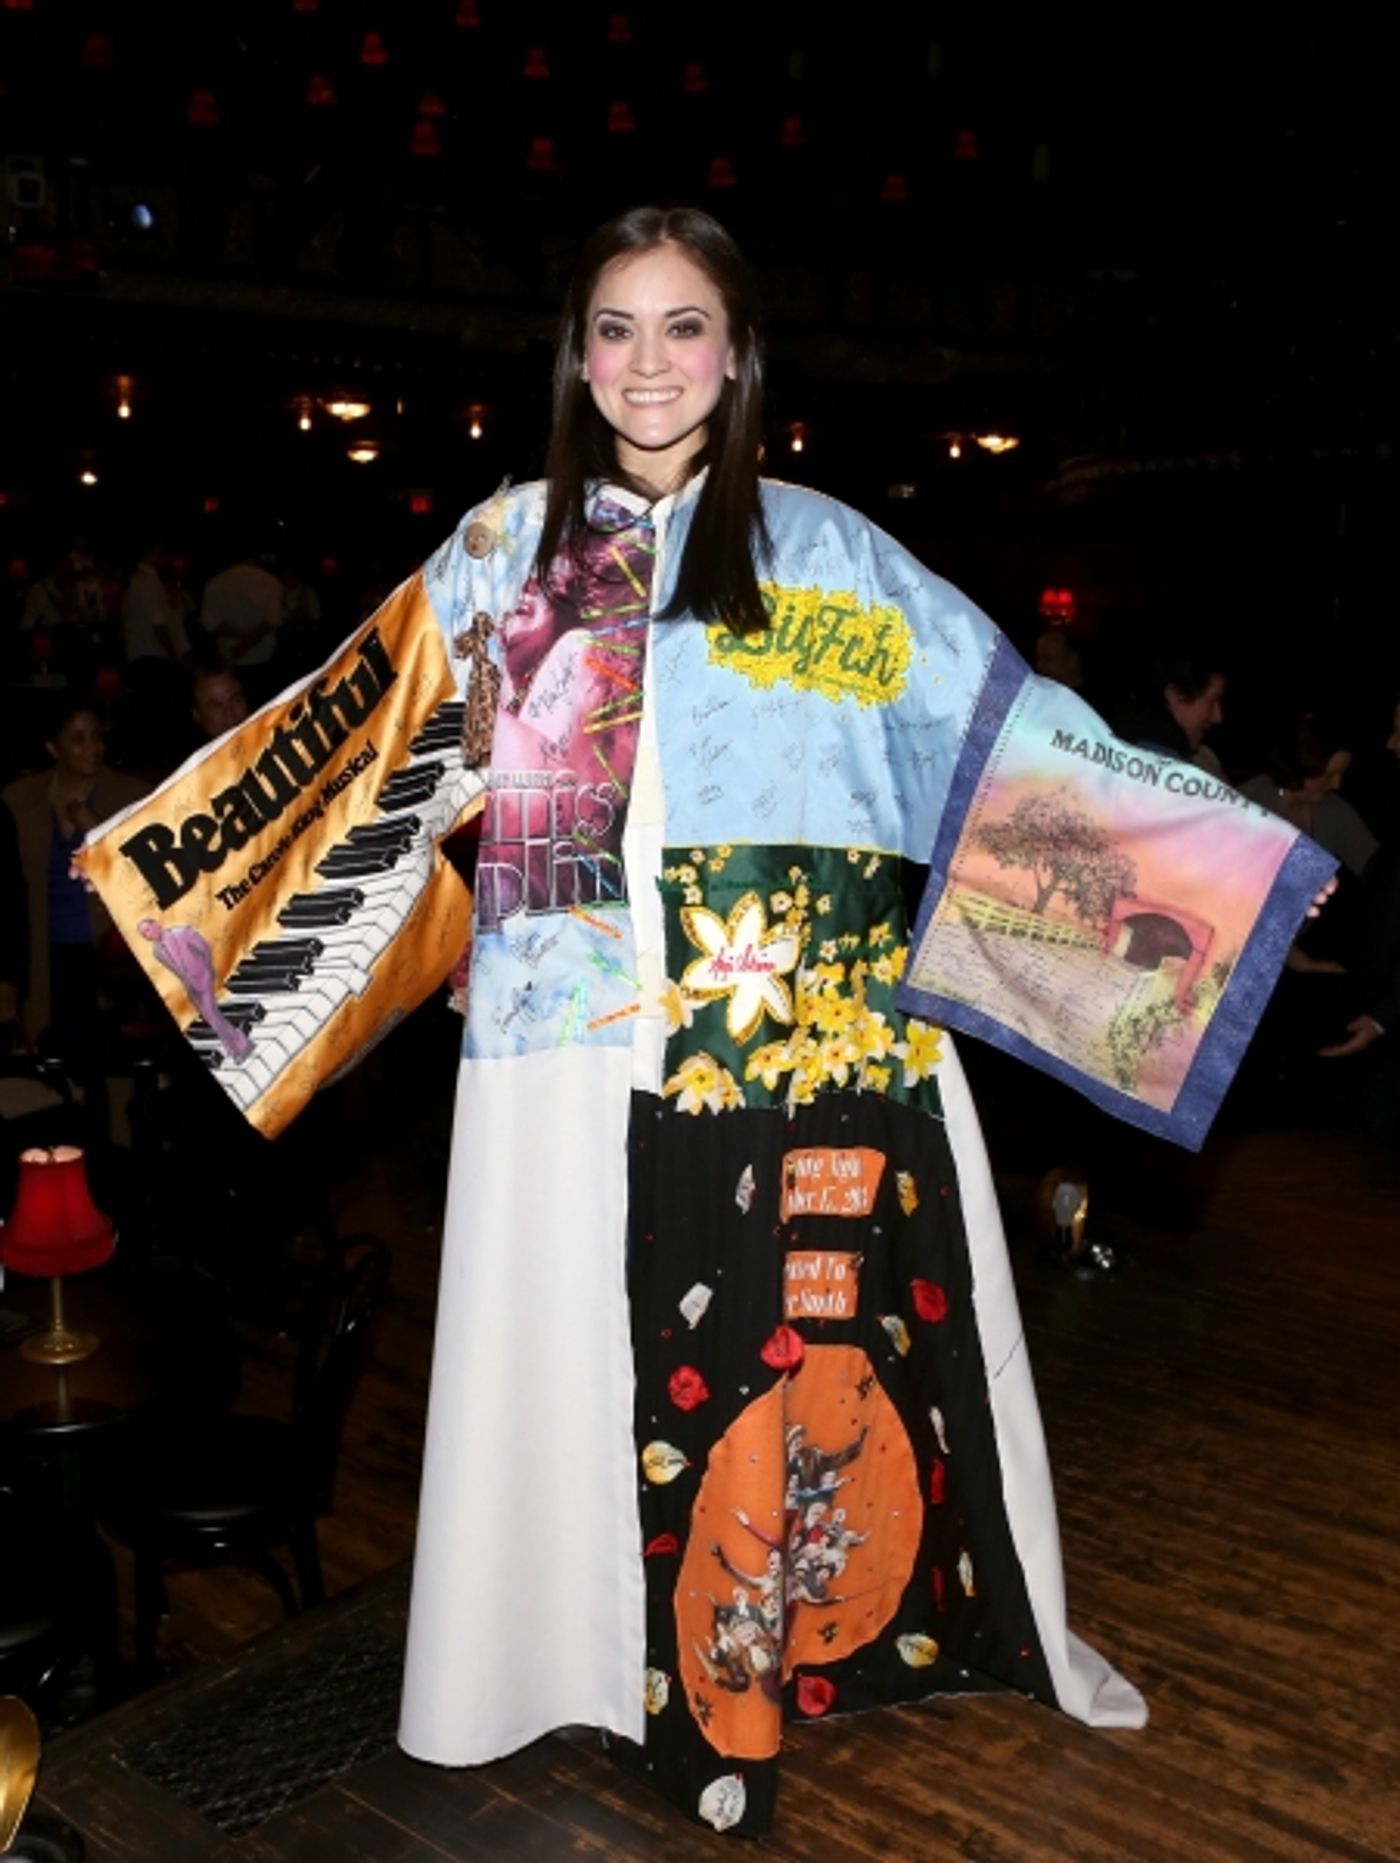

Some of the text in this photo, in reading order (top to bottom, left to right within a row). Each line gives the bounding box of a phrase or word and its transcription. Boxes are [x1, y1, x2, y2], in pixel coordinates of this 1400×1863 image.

[118, 627, 398, 912] Beautiful
[214, 878, 250, 909] The
[321, 737, 380, 807] Musical
[1050, 729, 1269, 818] MADISON COUN
